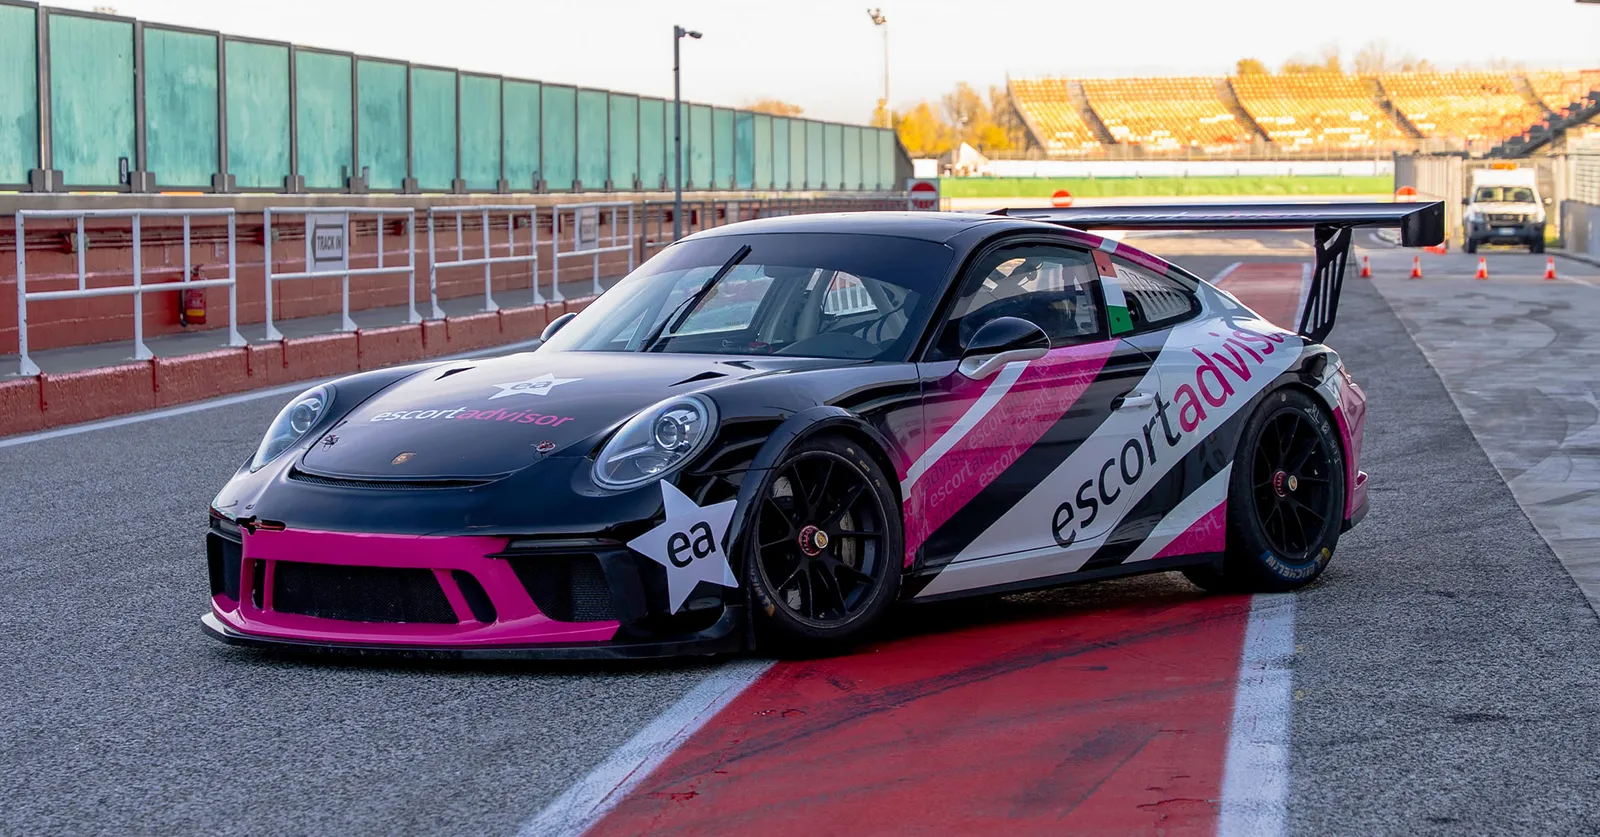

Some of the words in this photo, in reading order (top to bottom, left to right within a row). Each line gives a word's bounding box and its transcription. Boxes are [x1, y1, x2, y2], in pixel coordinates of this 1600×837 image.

[317, 235, 335, 251] TRACK
[510, 381, 553, 391] ea
[370, 406, 575, 428] escortadvisor
[667, 521, 717, 568] ea
